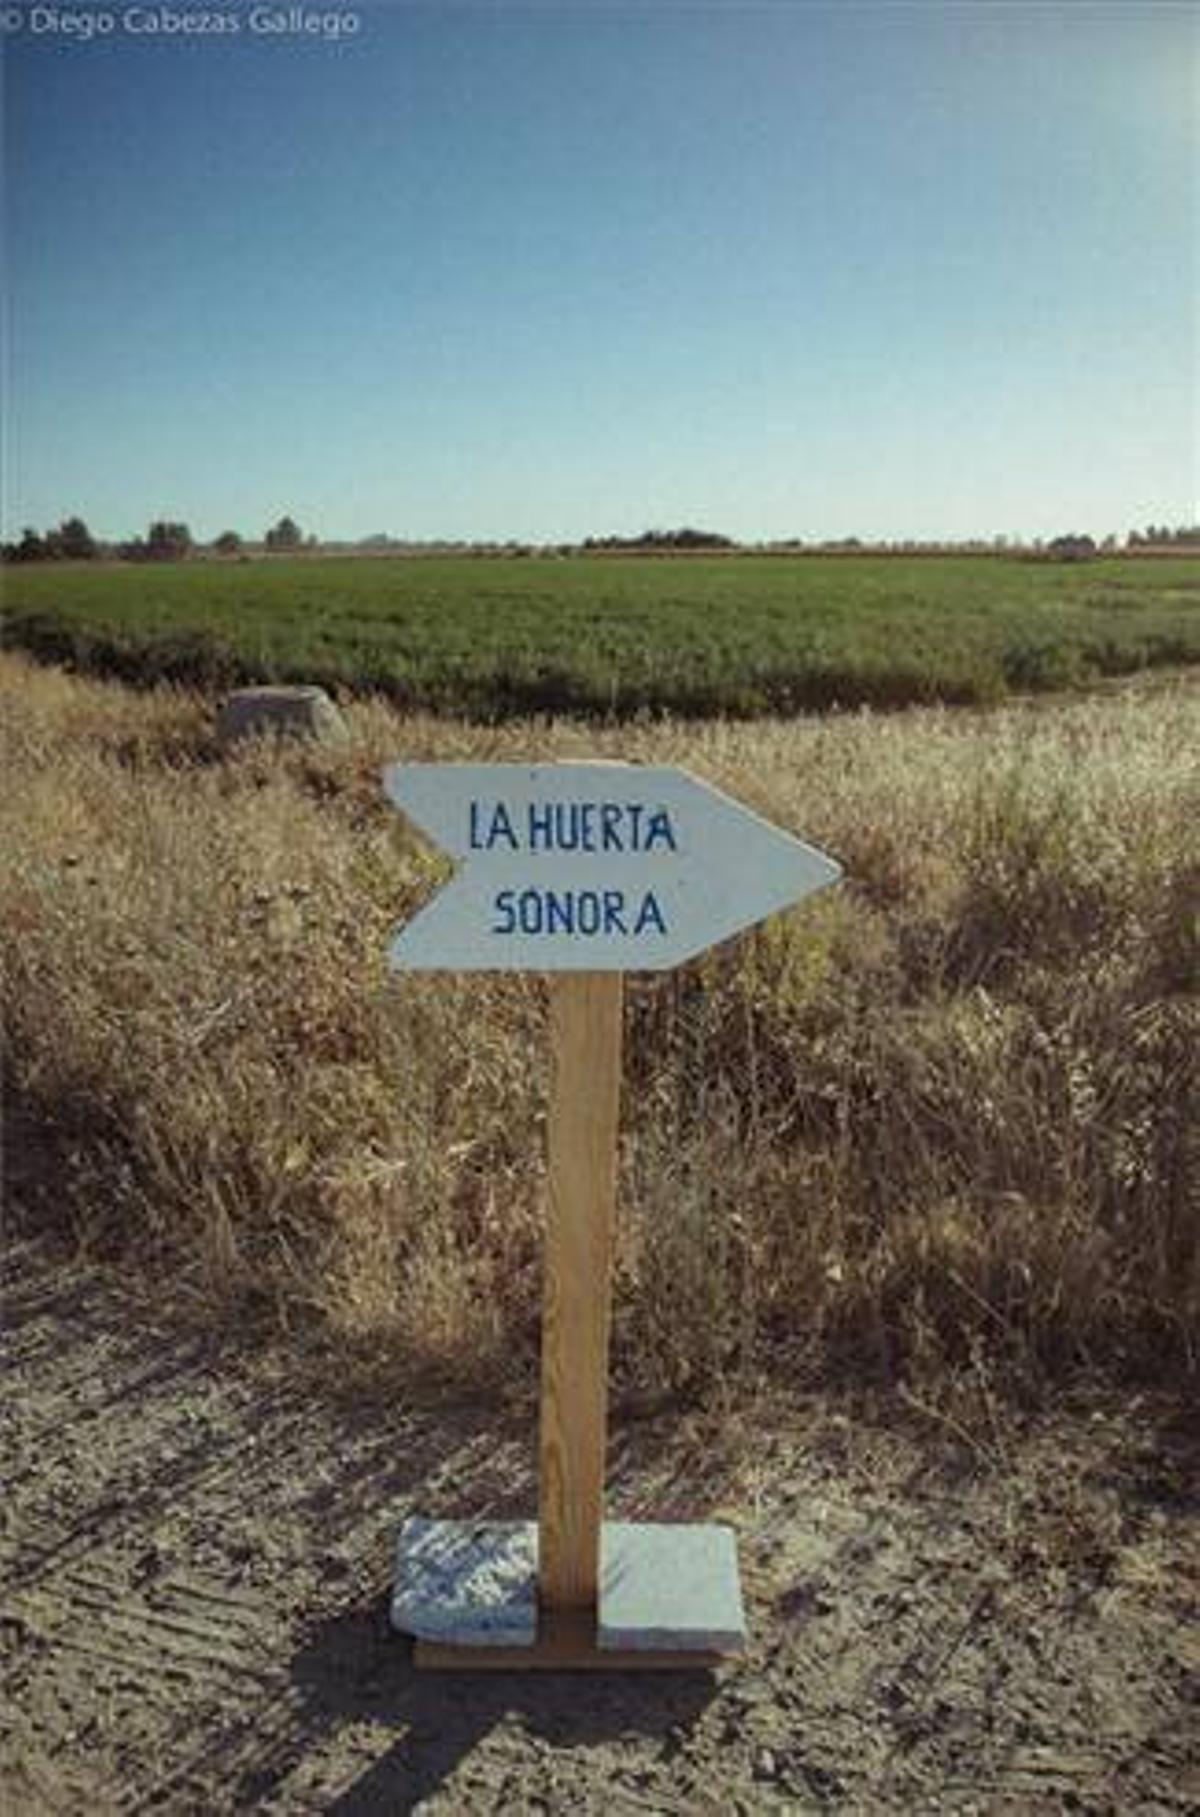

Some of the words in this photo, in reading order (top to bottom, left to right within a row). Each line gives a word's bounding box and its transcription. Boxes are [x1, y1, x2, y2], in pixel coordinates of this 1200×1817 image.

[469, 801, 519, 849] LA
[529, 803, 677, 851] HUERTA
[493, 888, 667, 935] SONORA
